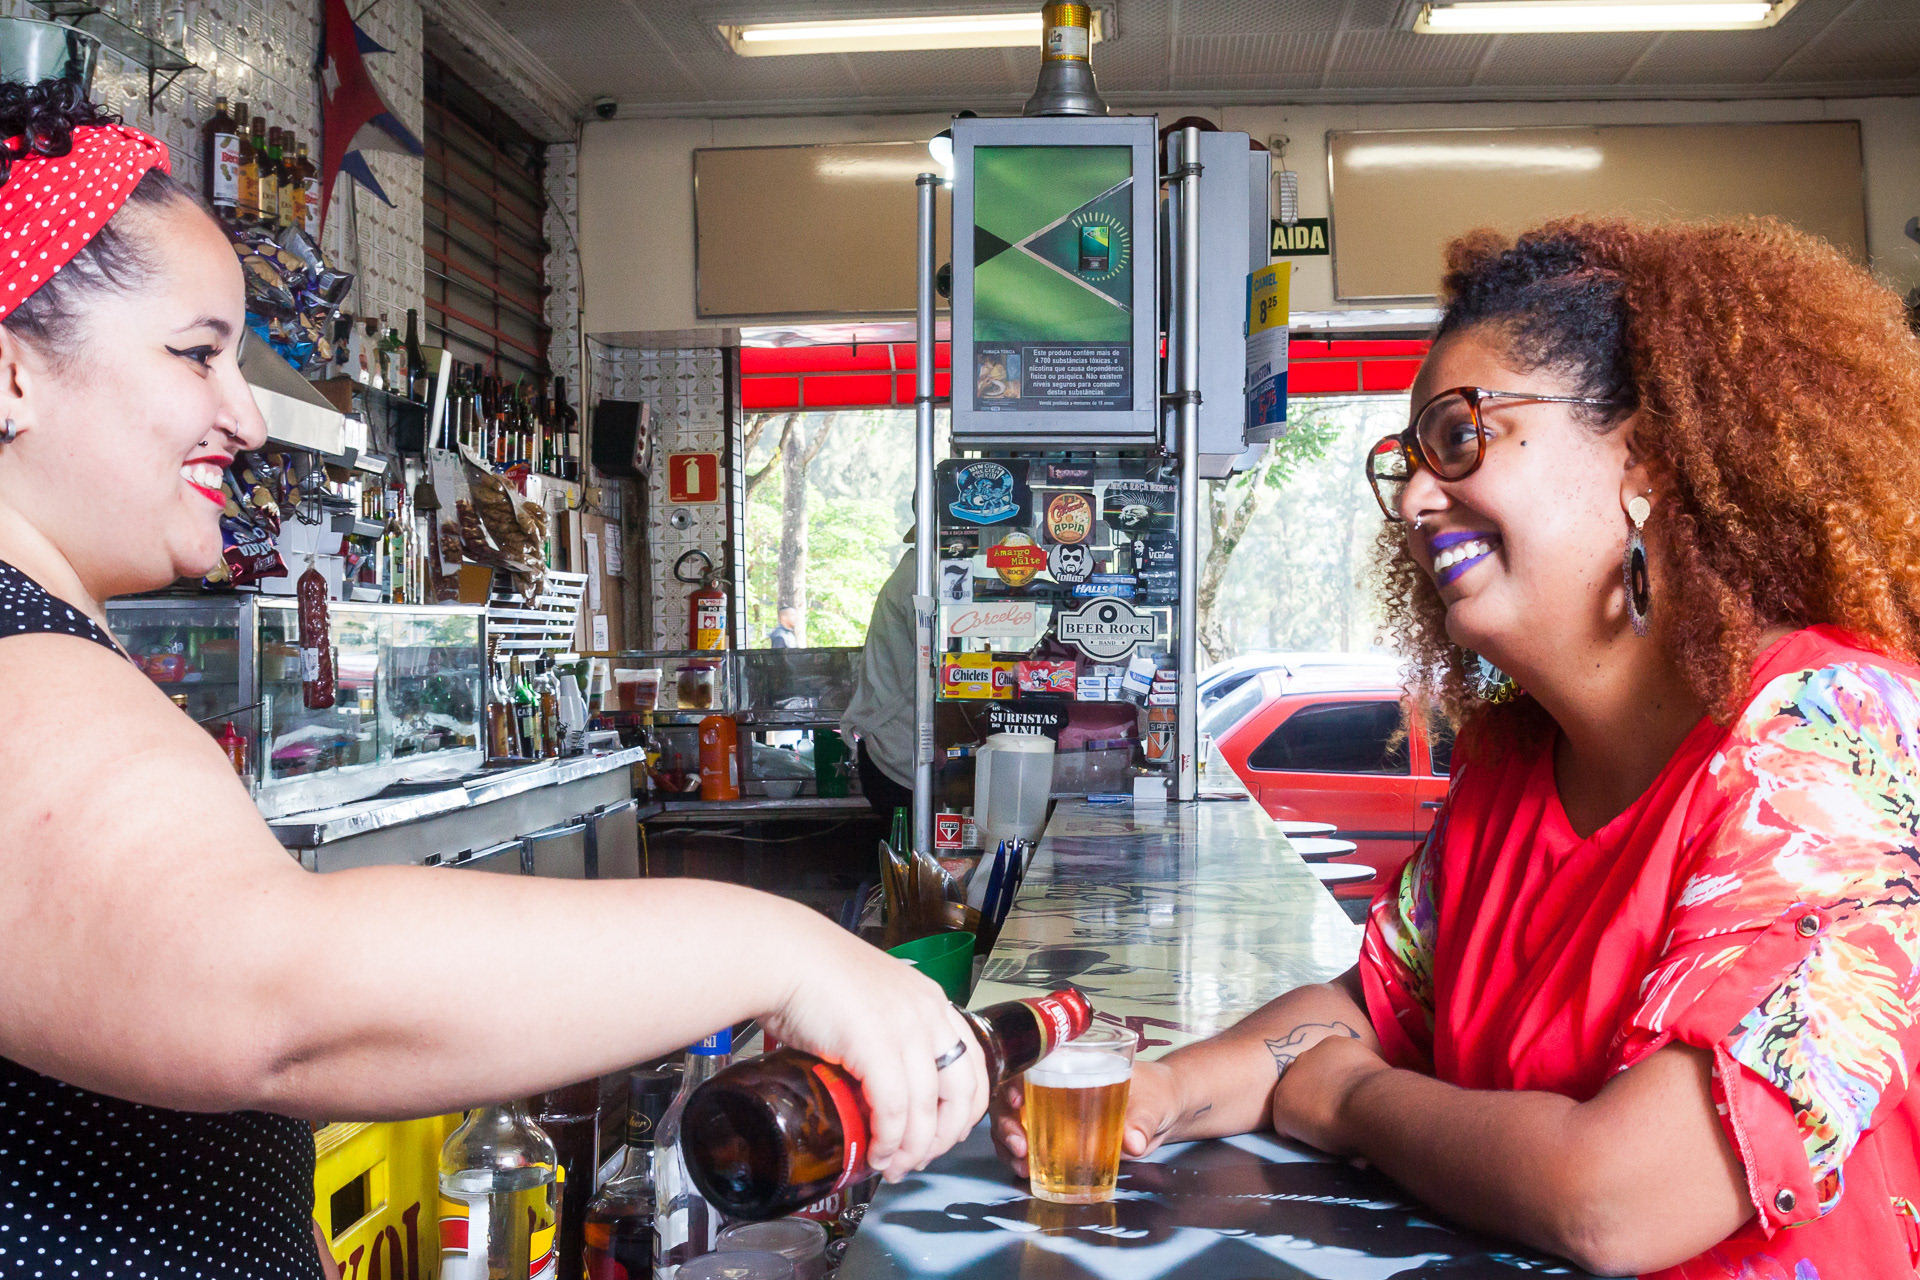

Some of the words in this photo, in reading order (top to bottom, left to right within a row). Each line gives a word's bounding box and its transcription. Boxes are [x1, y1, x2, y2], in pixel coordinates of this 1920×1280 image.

[1272, 226, 1326, 250] AIDA
[1254, 272, 1278, 292] CAMEL
[1048, 349, 1072, 357] produto
[1086, 365, 1124, 373] dependência
[1054, 523, 1085, 536] APPIA
[237, 540, 271, 556] ATATA
[994, 548, 1031, 558] Amargo
[1011, 557, 1041, 566] Malte
[1075, 584, 1109, 594] HALLS
[917, 609, 931, 628] Win
[1066, 624, 1104, 634] BEER
[1109, 624, 1150, 635] ROCK
[953, 668, 989, 682] Chiclets
[997, 672, 1014, 685] Chic
[990, 712, 1058, 725] SURFISTAS
[1150, 723, 1176, 732] SPFC
